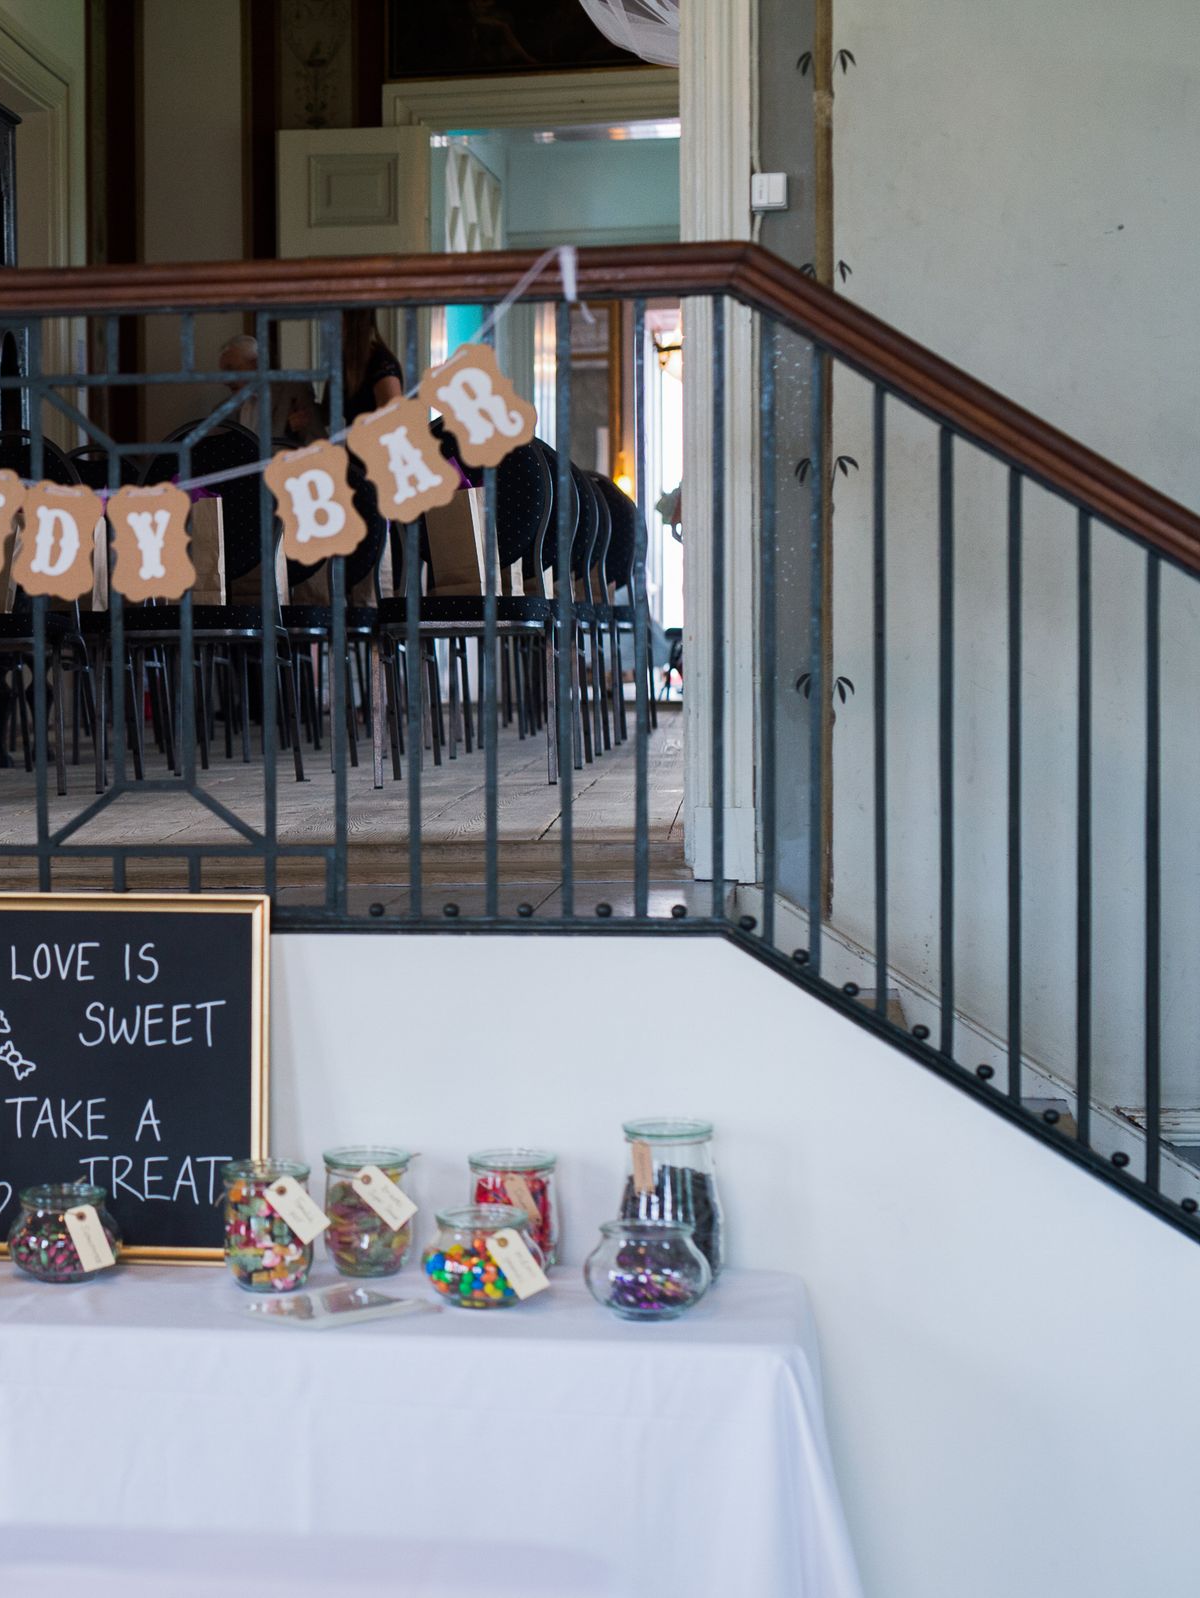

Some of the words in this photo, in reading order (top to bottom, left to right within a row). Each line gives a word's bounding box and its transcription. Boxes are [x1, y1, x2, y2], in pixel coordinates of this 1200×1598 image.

[284, 367, 524, 543] BAR
[10, 942, 100, 982] LOVE
[124, 942, 160, 984] IS
[78, 1000, 227, 1047] SWEET
[4, 1095, 109, 1141] TAKE
[134, 1097, 162, 1142] A
[78, 1155, 233, 1205] TREAT
